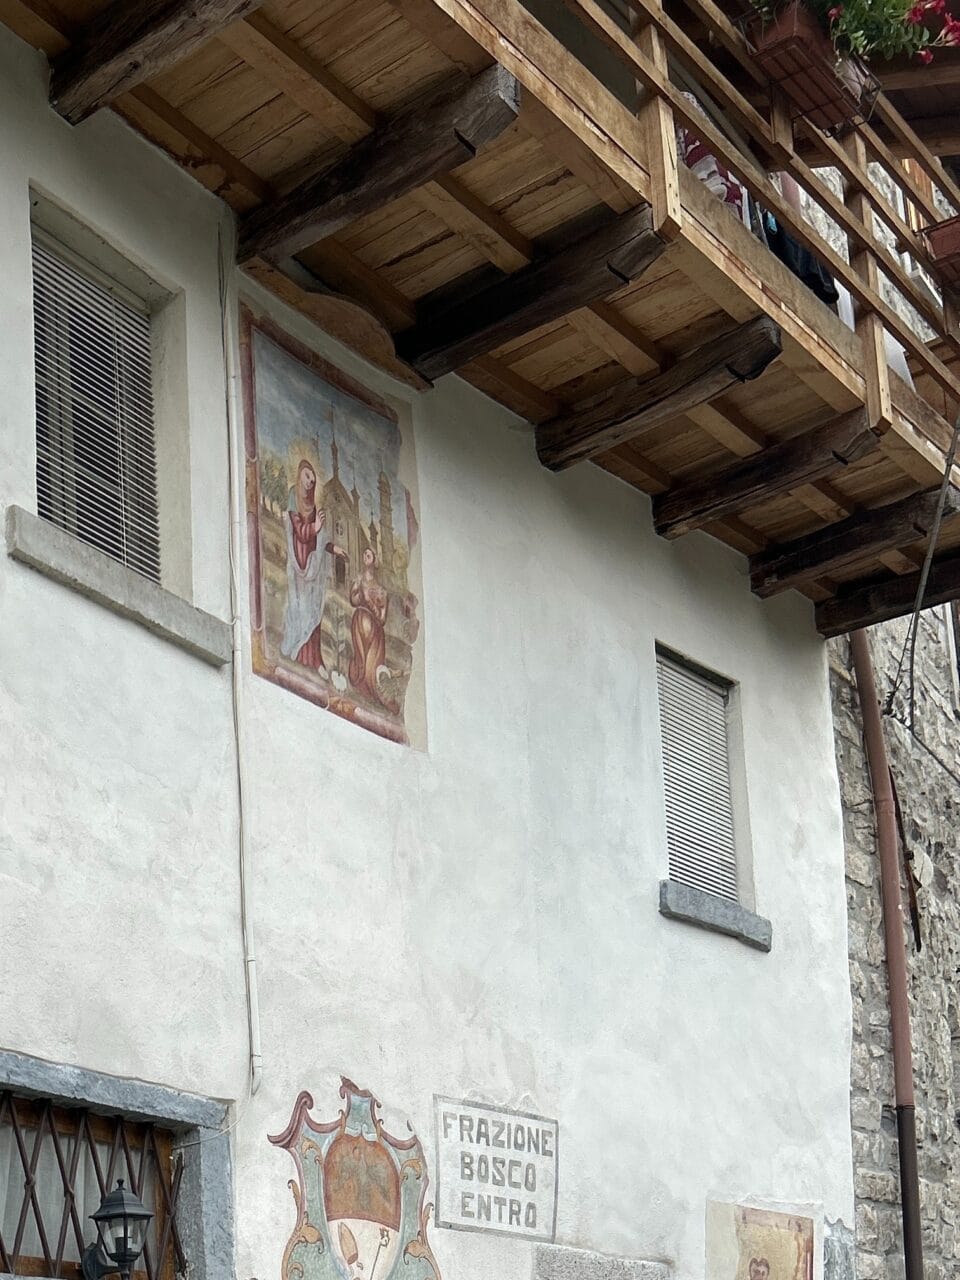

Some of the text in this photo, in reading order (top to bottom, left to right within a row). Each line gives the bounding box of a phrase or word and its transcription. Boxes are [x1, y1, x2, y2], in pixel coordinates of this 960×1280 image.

[442, 1111, 554, 1158] FRAZIONE
[460, 1150, 537, 1193] BOSCO
[461, 1191, 537, 1229] ENTRO
